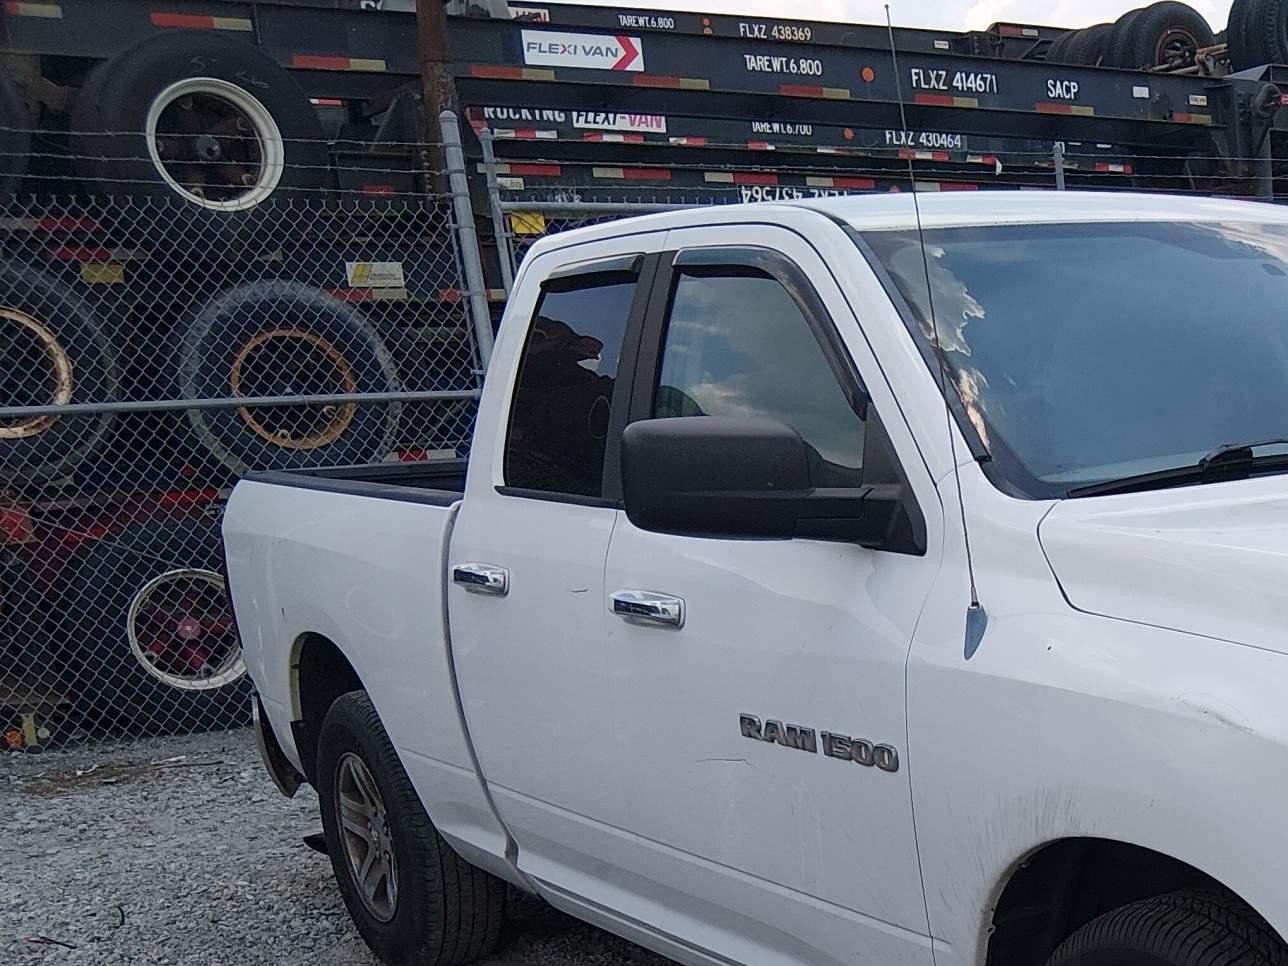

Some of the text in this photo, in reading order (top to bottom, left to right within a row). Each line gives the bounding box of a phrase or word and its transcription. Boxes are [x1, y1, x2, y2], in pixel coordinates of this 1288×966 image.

[739, 23, 812, 41] FLXZ 438369
[526, 41, 619, 58] FLEXI VAN
[911, 68, 998, 93] FLXZ 414671
[1047, 79, 1079, 100] SACP
[884, 130, 962, 148] FLXZ 430464
[739, 712, 900, 773] RAM 1500
